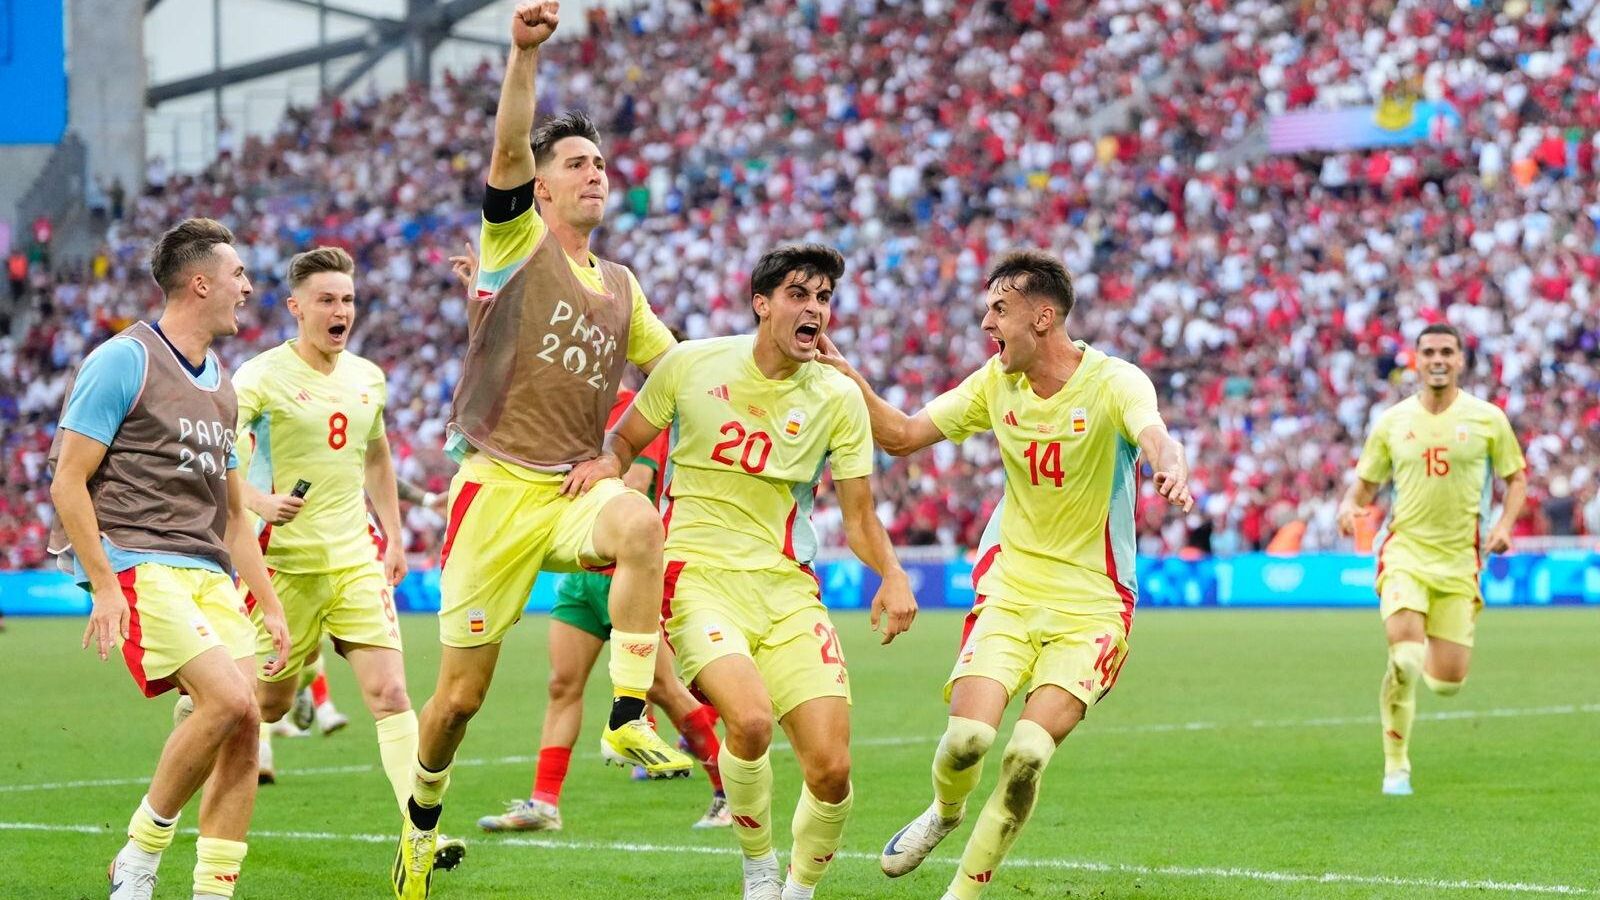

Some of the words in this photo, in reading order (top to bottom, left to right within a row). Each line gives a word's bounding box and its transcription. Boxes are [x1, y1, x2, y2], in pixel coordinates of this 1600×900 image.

[328, 412, 348, 450] 8
[711, 421, 773, 474] 20
[1024, 441, 1065, 488] 14
[1421, 447, 1449, 477] 15
[381, 589, 395, 623] 8
[1094, 634, 1119, 688] 14
